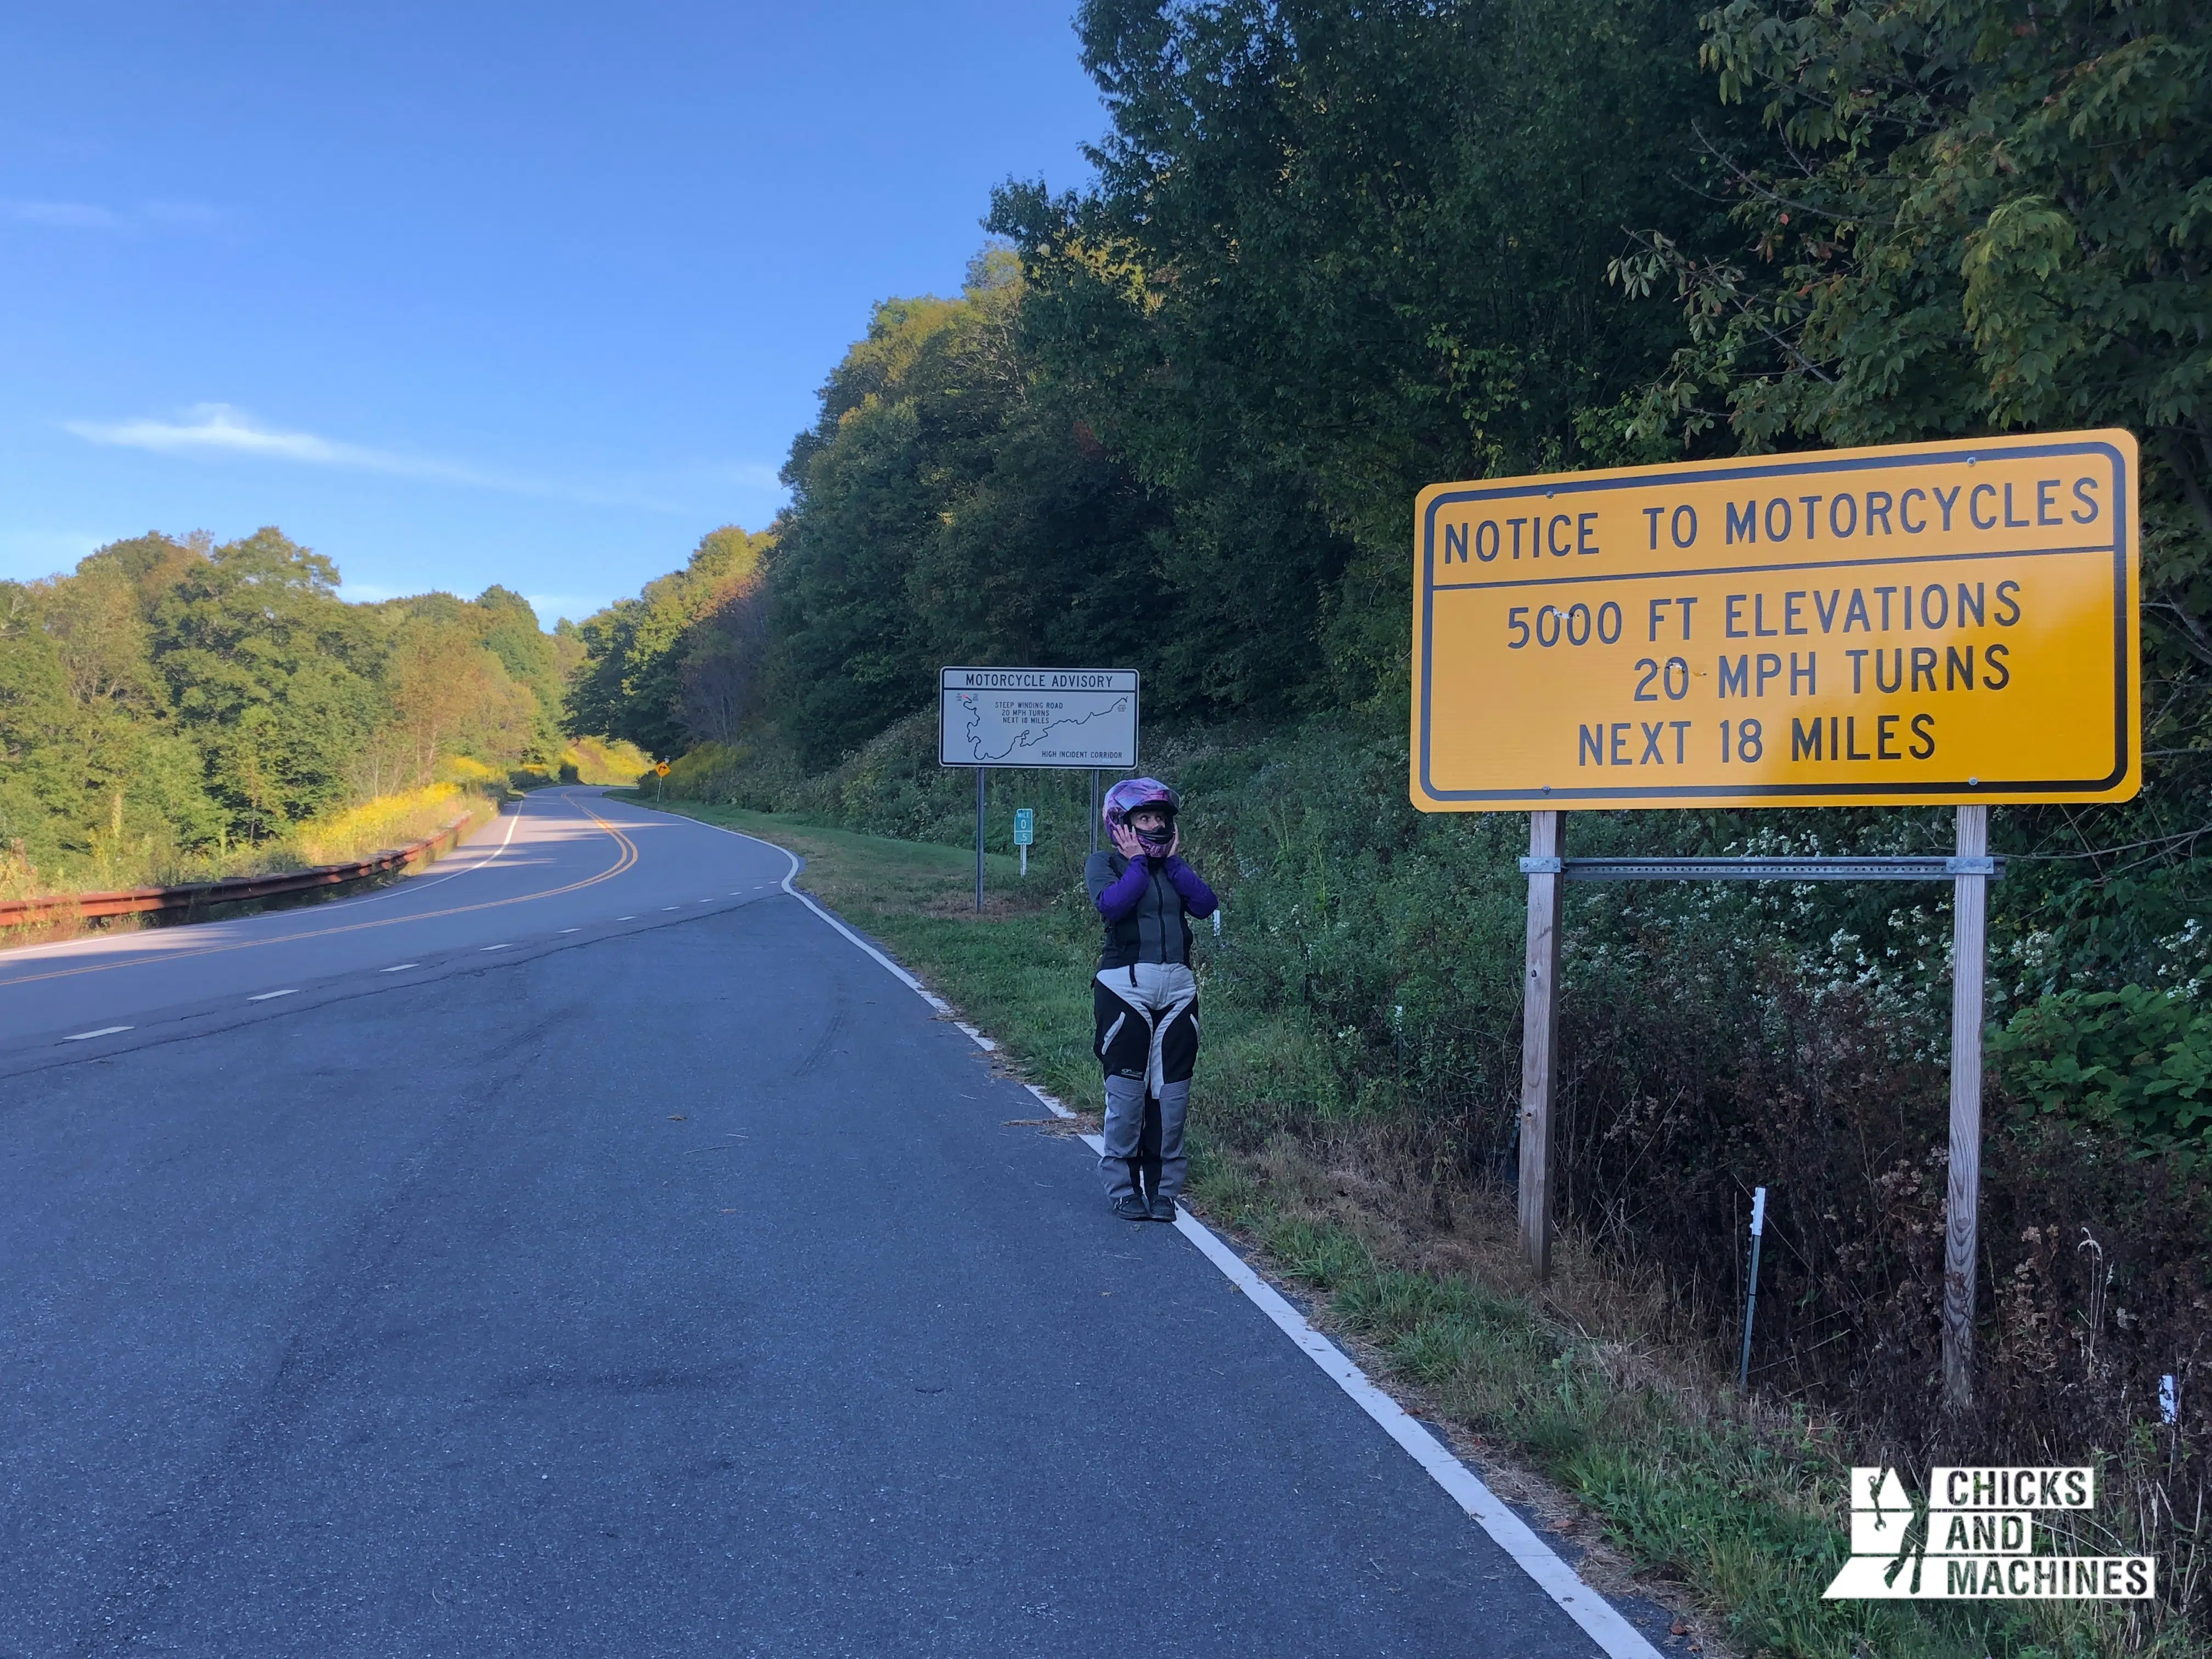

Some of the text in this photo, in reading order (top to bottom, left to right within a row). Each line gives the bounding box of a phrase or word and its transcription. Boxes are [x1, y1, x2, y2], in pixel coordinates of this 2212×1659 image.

[1444, 476, 2098, 565] NOTICE TO MOTORCYCLES
[1507, 580, 2021, 649] 5000 FT ELEVATIONS
[966, 673, 1113, 688] MOTORCYCLE ADVISORY
[1634, 644, 2010, 702] 20 MPH TURNS
[1579, 713, 1935, 766] NEXT 18 MILES
[1020, 819, 1026, 829] 0
[1021, 833, 1027, 842] 5
